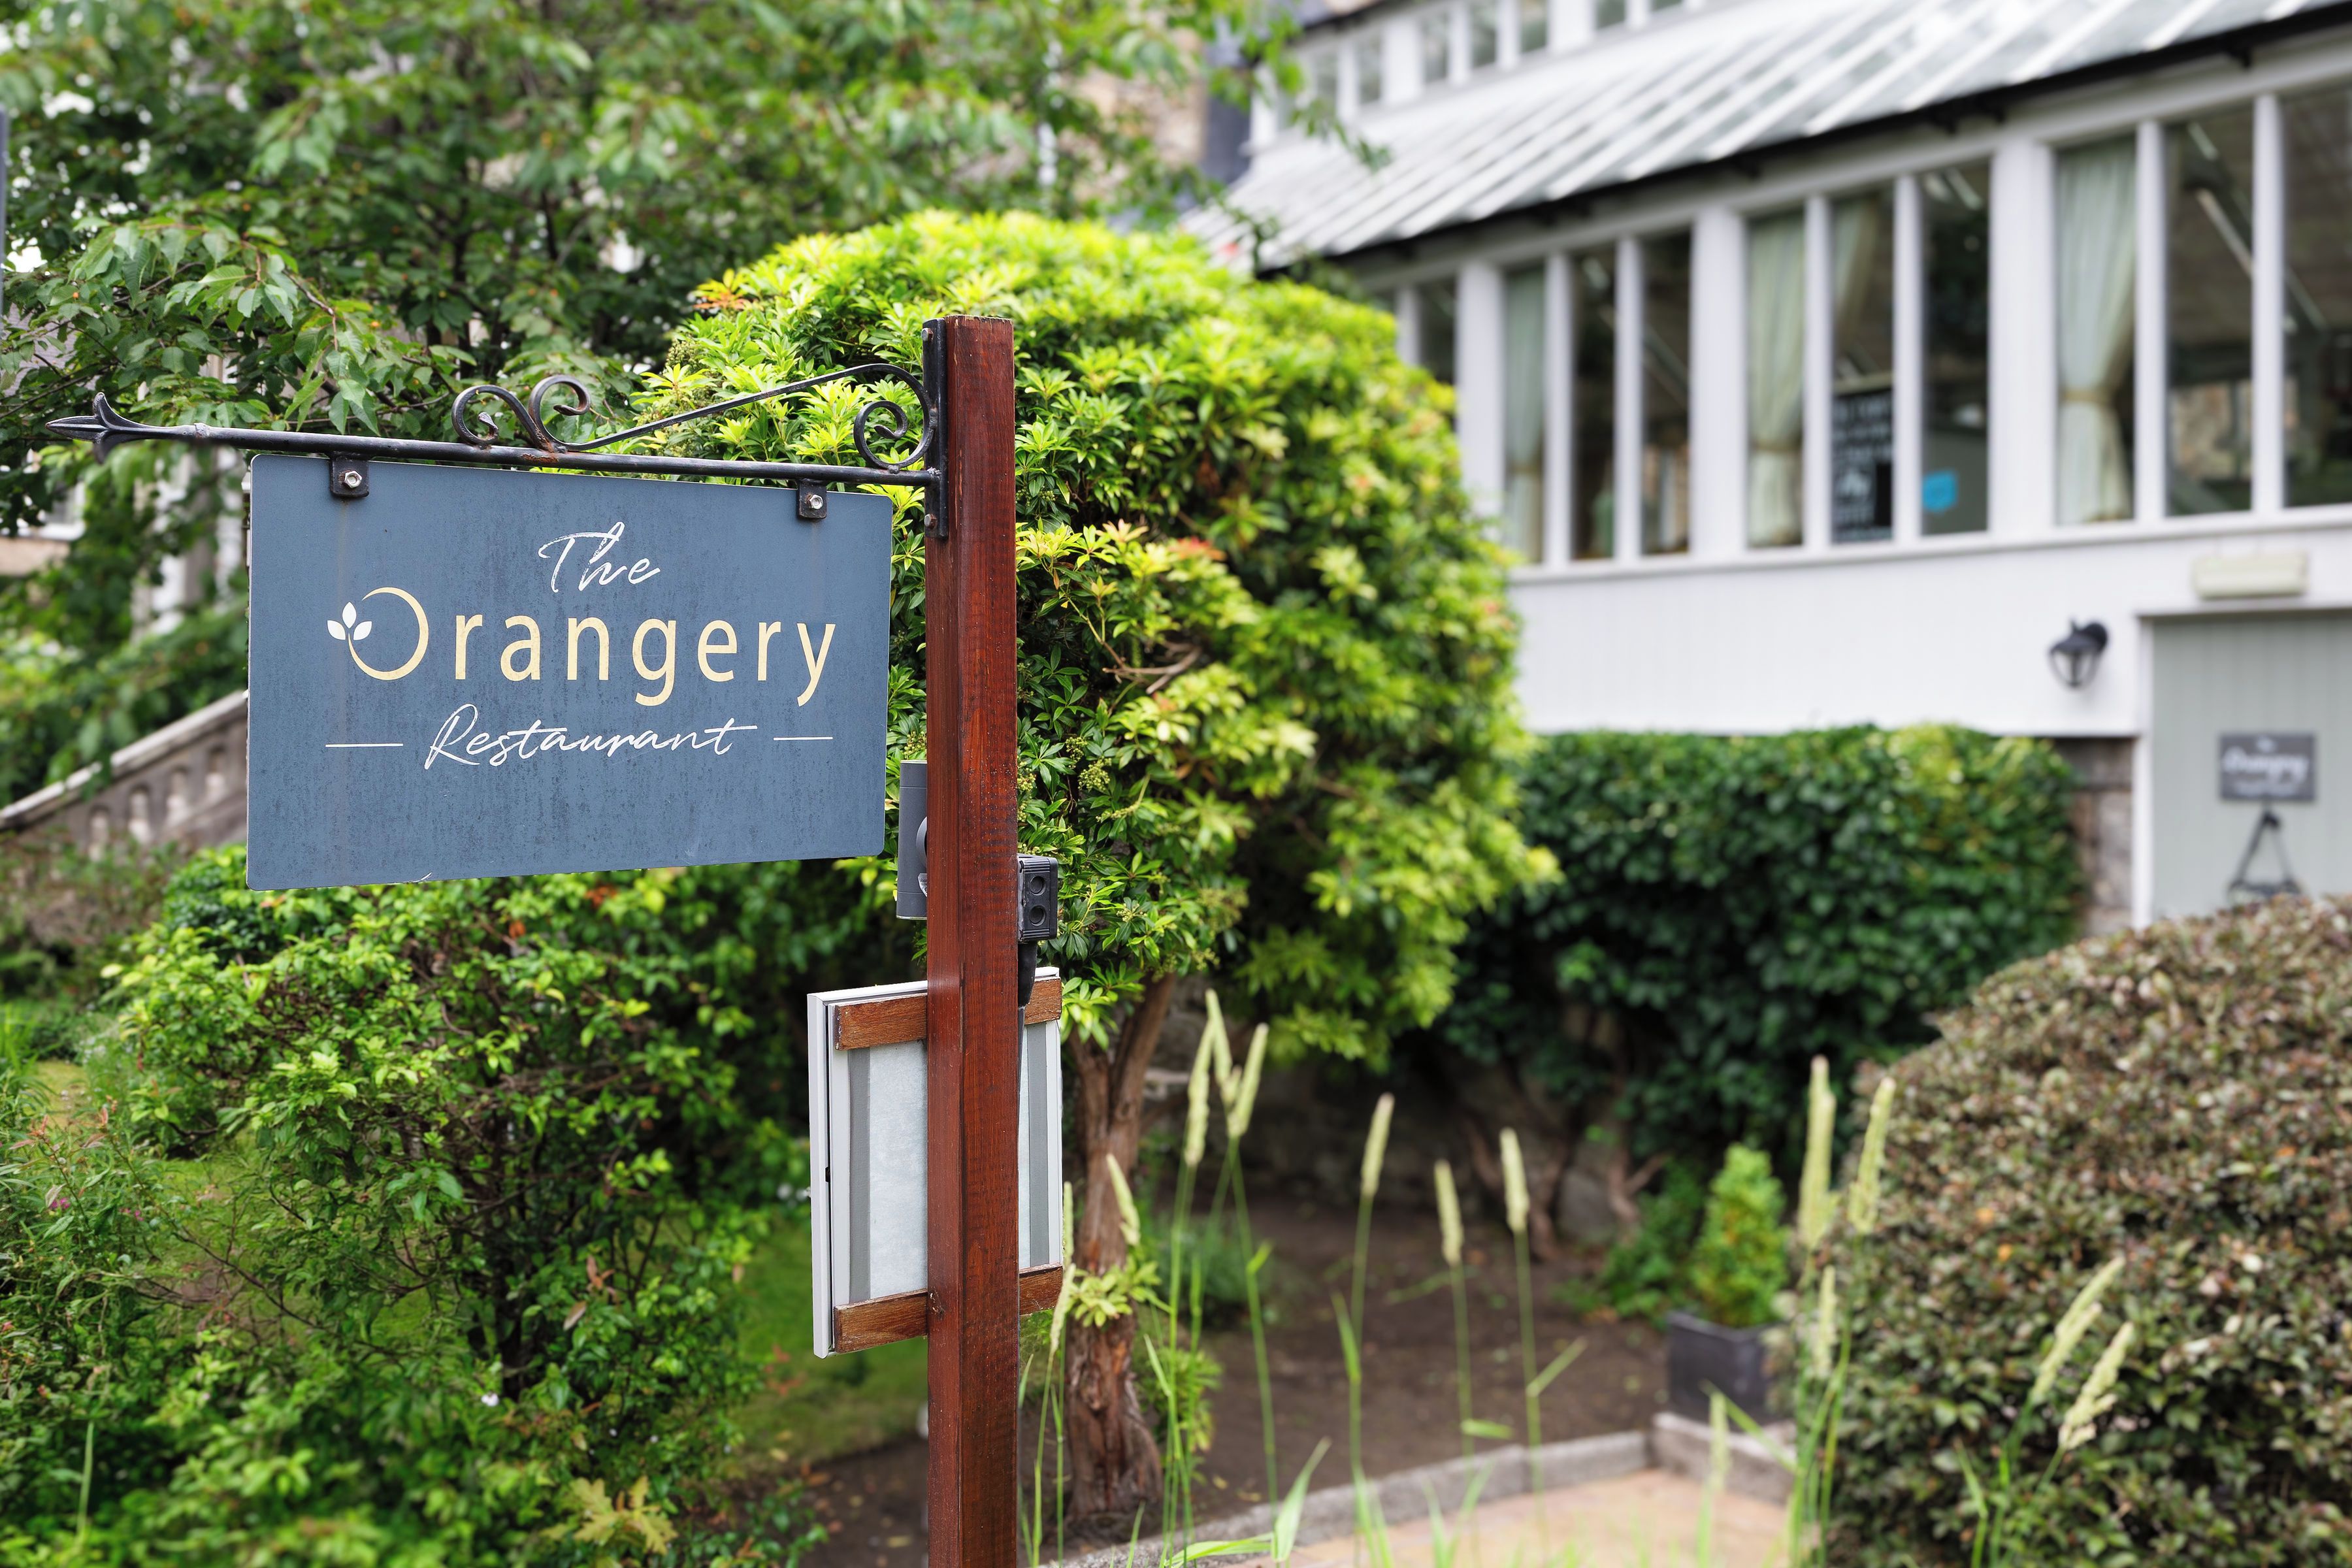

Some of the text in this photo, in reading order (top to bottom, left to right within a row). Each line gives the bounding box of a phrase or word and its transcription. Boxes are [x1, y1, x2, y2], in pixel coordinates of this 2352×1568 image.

[538, 522, 661, 593] The
[348, 587, 836, 707] Orangery
[425, 704, 758, 770] Restaurant
